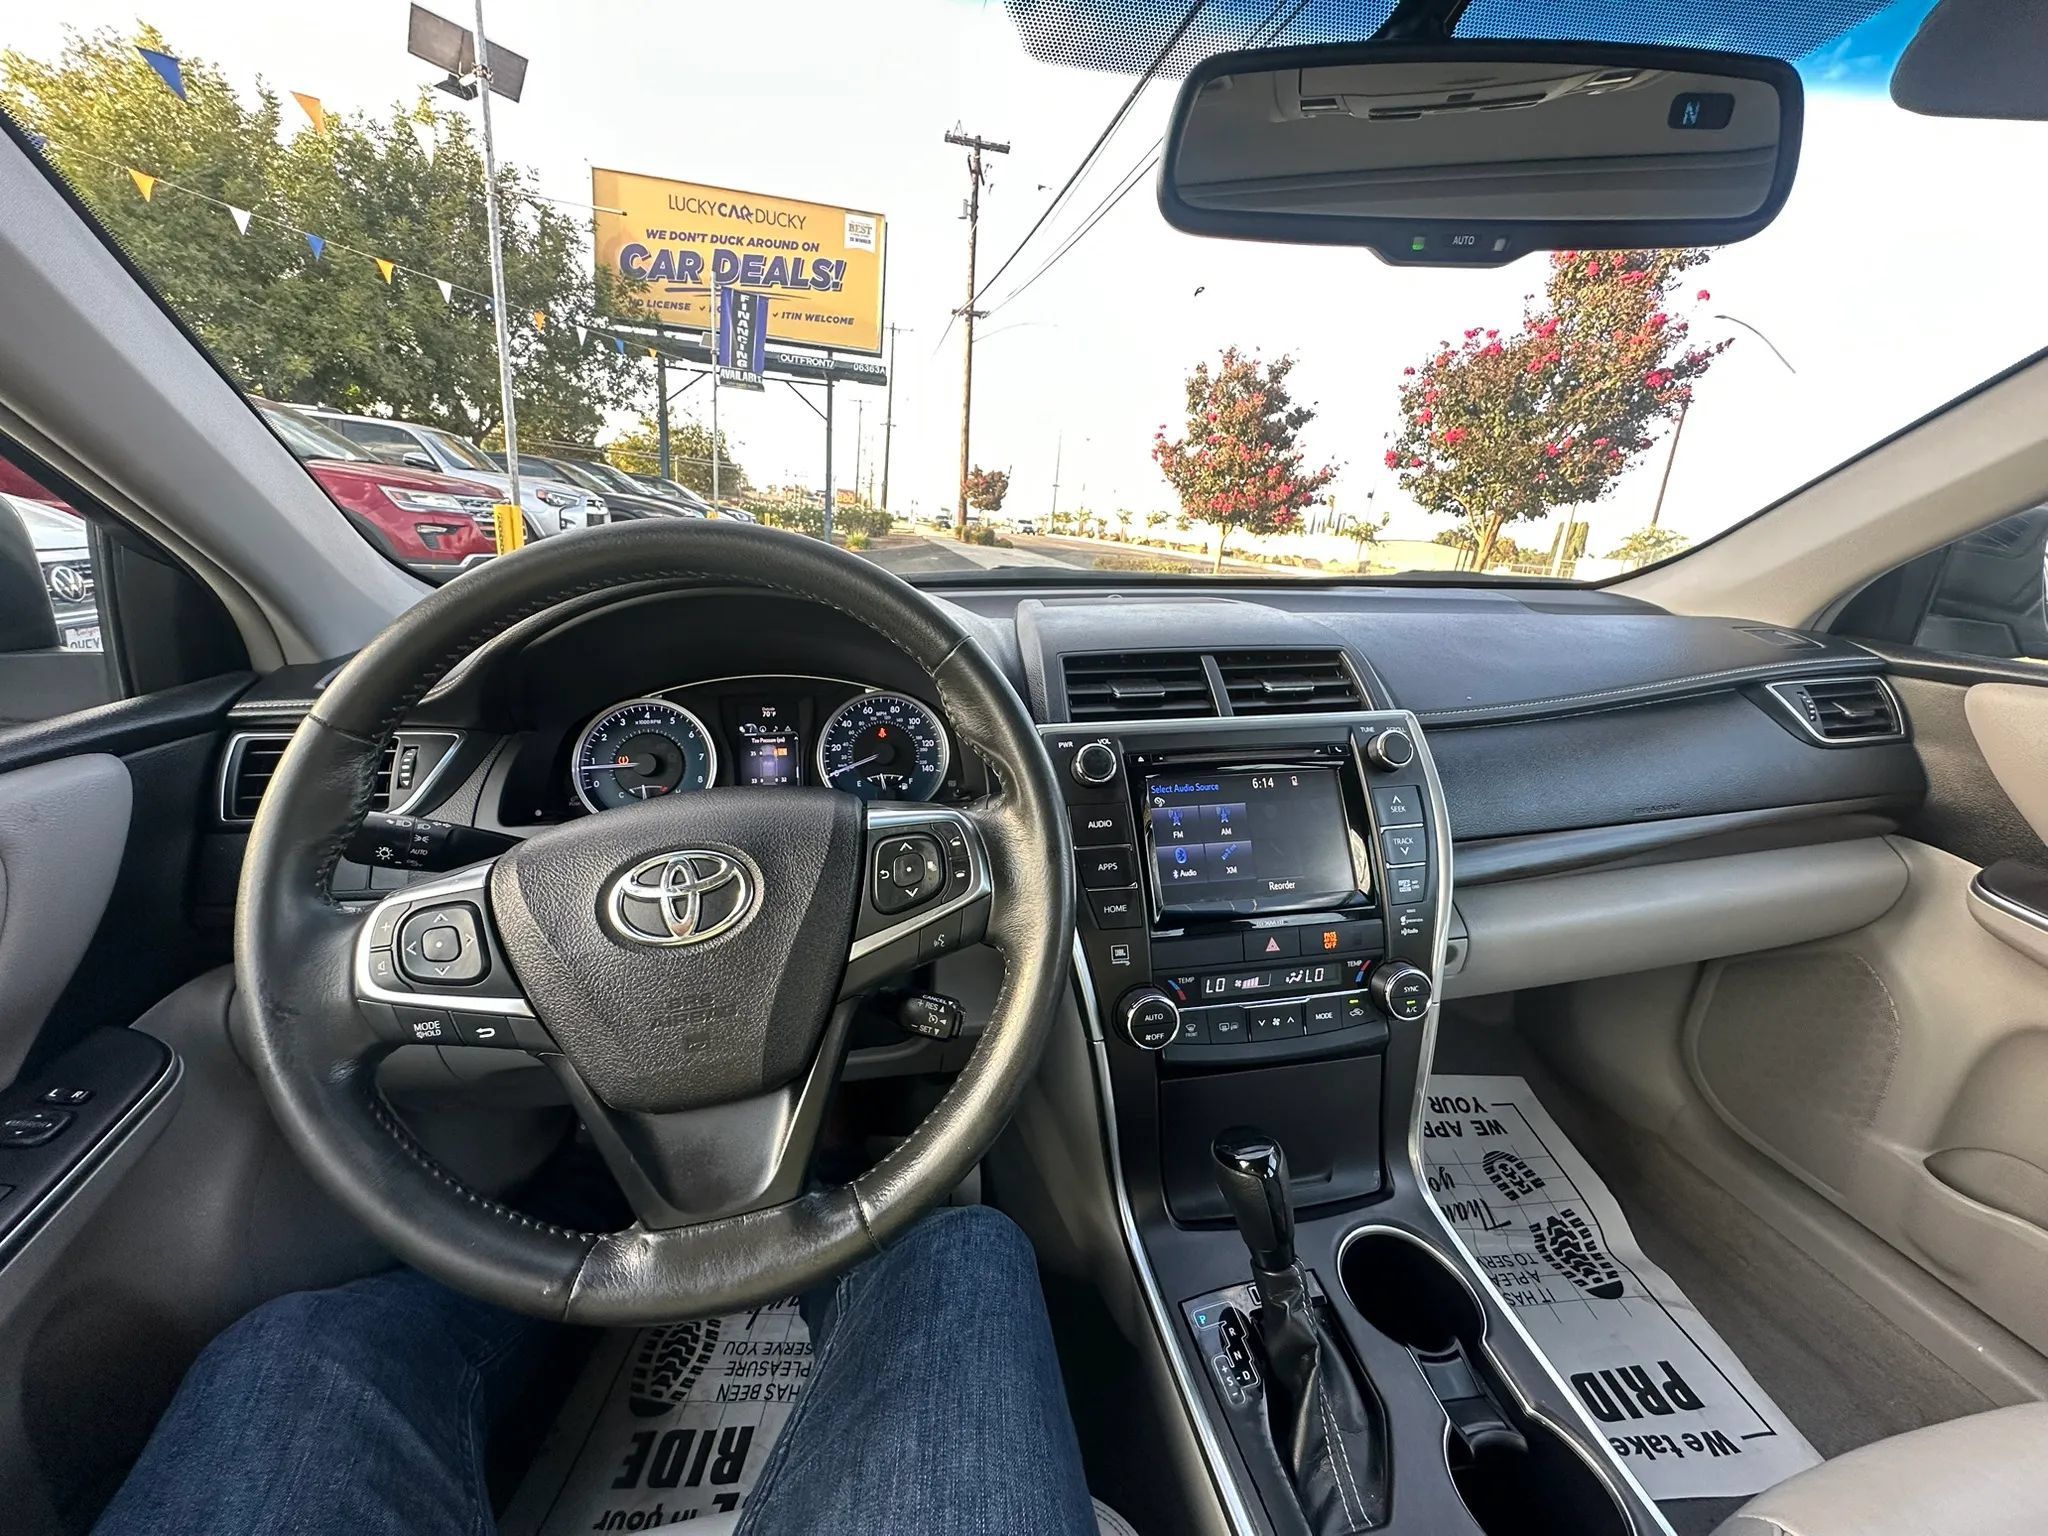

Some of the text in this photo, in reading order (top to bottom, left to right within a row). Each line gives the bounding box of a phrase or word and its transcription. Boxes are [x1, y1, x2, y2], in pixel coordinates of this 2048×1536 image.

[1682, 100, 1700, 125] N
[848, 223, 873, 235] BEST
[646, 229, 820, 252] WE DON'T DUCK AROUND ON
[1452, 235, 1475, 245] AUTO
[620, 243, 847, 292] CAR DEALS!
[647, 299, 692, 311] LICENSE
[781, 311, 855, 325] ITIN WELCOME
[736, 294, 751, 368] FINANCING
[720, 368, 763, 384] AVAILABLE
[890, 706, 900, 714] 80
[620, 718, 626, 726] 3
[909, 717, 920, 725] 100
[1058, 741, 1073, 749] PWR
[1151, 782, 1219, 794] Select Audio Source
[1252, 777, 1274, 789] 6:14
[1390, 805, 1406, 813] SEEK
[1088, 819, 1112, 829] AUDIO
[1173, 830, 1184, 839] FM
[1221, 827, 1232, 836] AM
[1393, 837, 1414, 845] TRACK
[1098, 862, 1118, 871] APPS
[1226, 866, 1238, 874] XM
[1180, 869, 1197, 878] Audio
[1269, 881, 1296, 891] Reorder
[1103, 904, 1128, 914] HOME
[1178, 976, 1195, 984] TEMP
[1404, 985, 1419, 993] SYNC
[922, 994, 947, 1005] CANCEL
[925, 1002, 938, 1011] RES
[1144, 1013, 1164, 1022] AUTO
[1315, 1011, 1333, 1020] MODE
[413, 1020, 440, 1031] MODE
[919, 1025, 933, 1033] SET
[424, 1029, 442, 1038] HOLD
[1151, 1033, 1165, 1041] OFF
[49, 1089, 58, 1097] L
[1428, 1096, 1488, 1114] YOUR
[1471, 1119, 1508, 1137] WE
[1514, 1253, 1538, 1266] TO
[1530, 1270, 1541, 1283] A
[1503, 1287, 1557, 1307] IT HAS
[1198, 1315, 1206, 1325] P
[1228, 1327, 1237, 1337] R
[723, 1341, 814, 1355] SERVE YOU
[1234, 1350, 1242, 1361] N
[725, 1361, 812, 1378] PLEASURE
[1242, 1370, 1250, 1381] D
[1226, 1376, 1234, 1387] S
[717, 1383, 801, 1402] HAS BEEN
[1611, 1430, 1742, 1461] We take
[611, 1425, 755, 1490] RIDE
